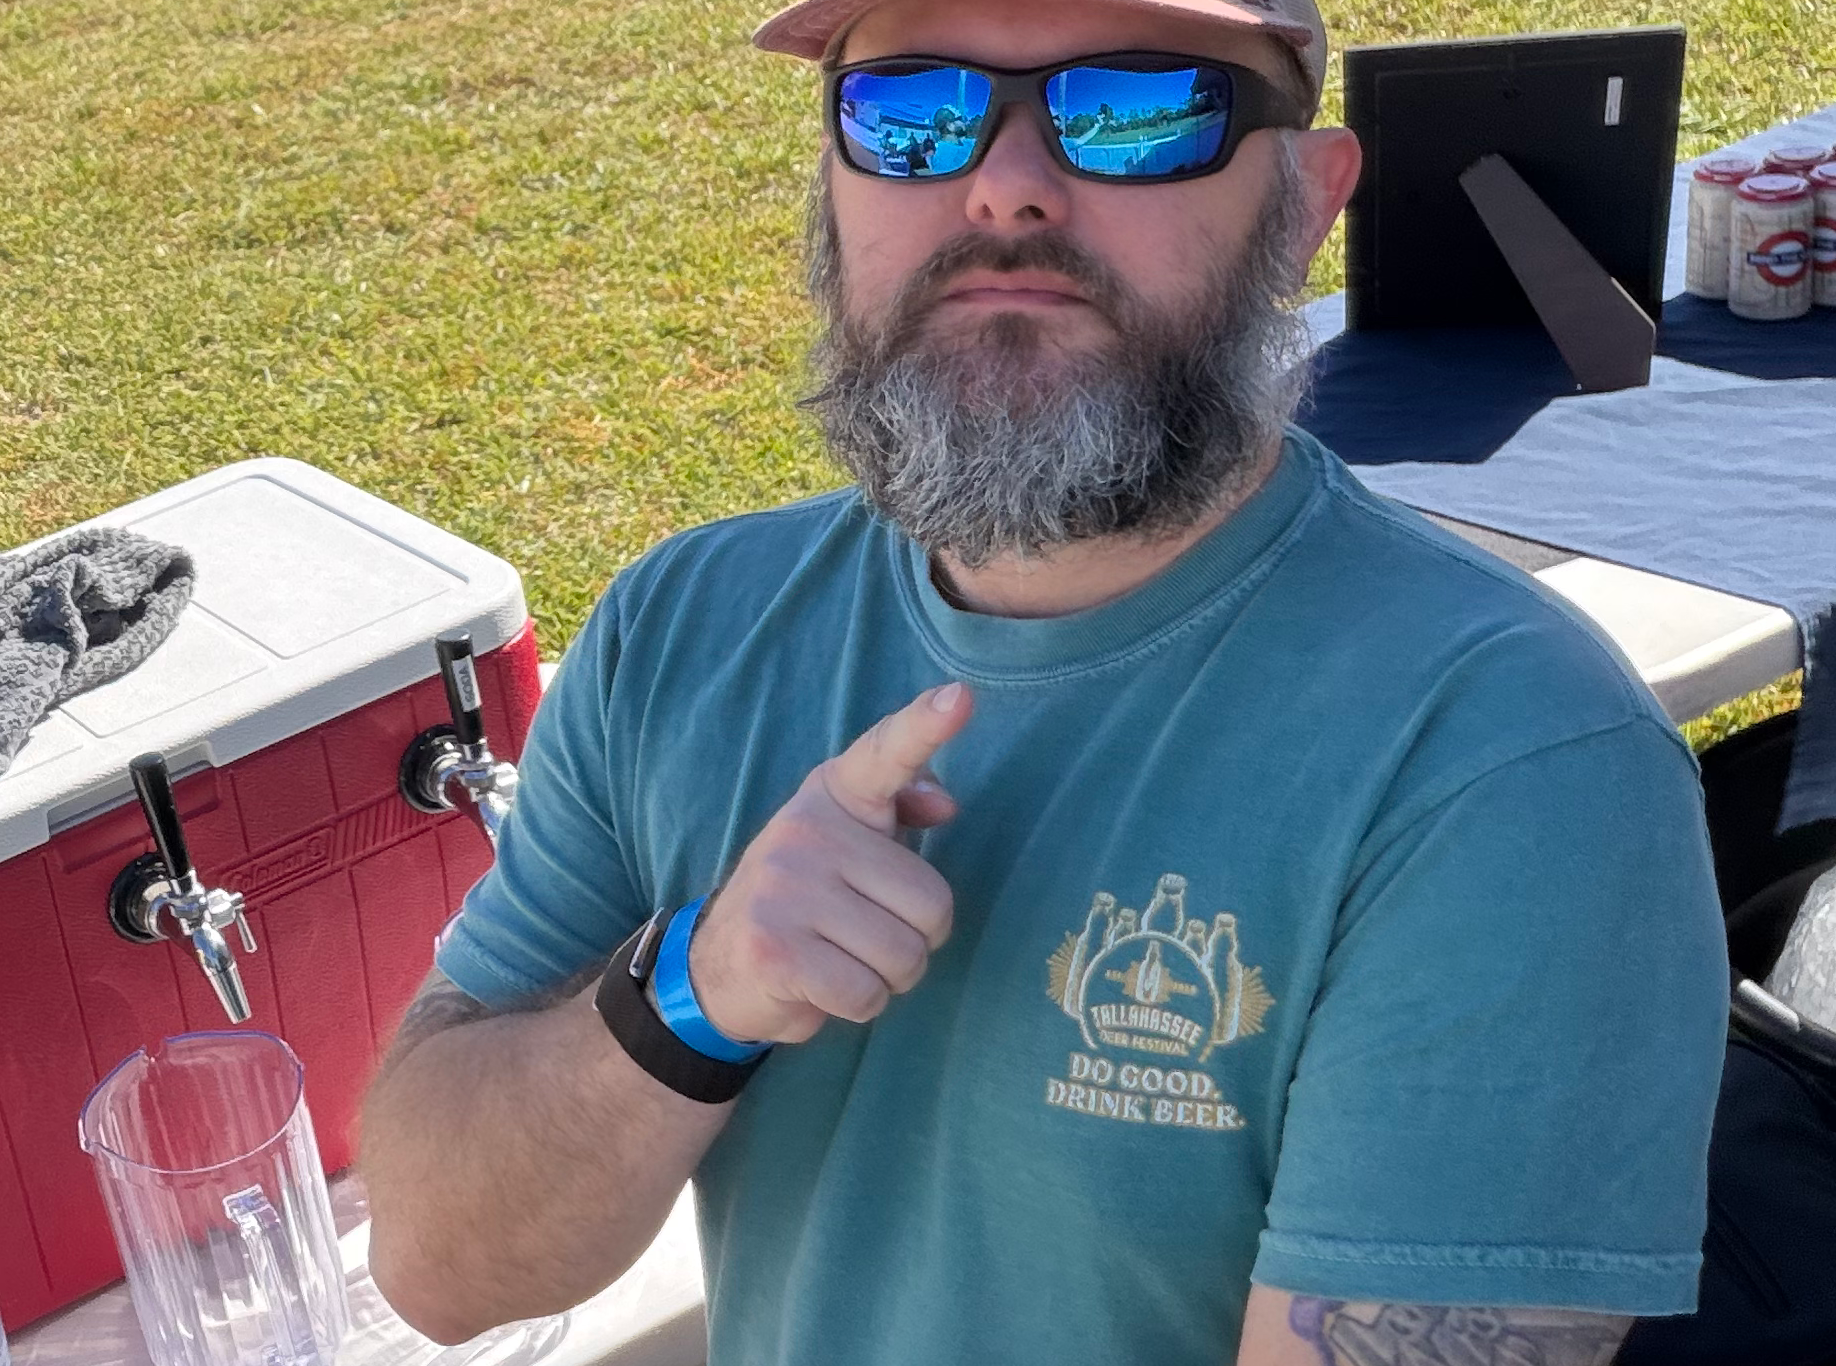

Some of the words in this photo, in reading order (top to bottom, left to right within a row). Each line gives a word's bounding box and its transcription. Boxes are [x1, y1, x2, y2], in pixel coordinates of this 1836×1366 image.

[1090, 1002, 1204, 1046] TALLAHASSEE
[1131, 1034, 1190, 1057] FESTIVAL
[1069, 1051, 1113, 1084] DO
[1119, 1064, 1223, 1100] GOOD.
[1045, 1078, 1146, 1123] DRINK
[1149, 1097, 1246, 1130] BEER.
